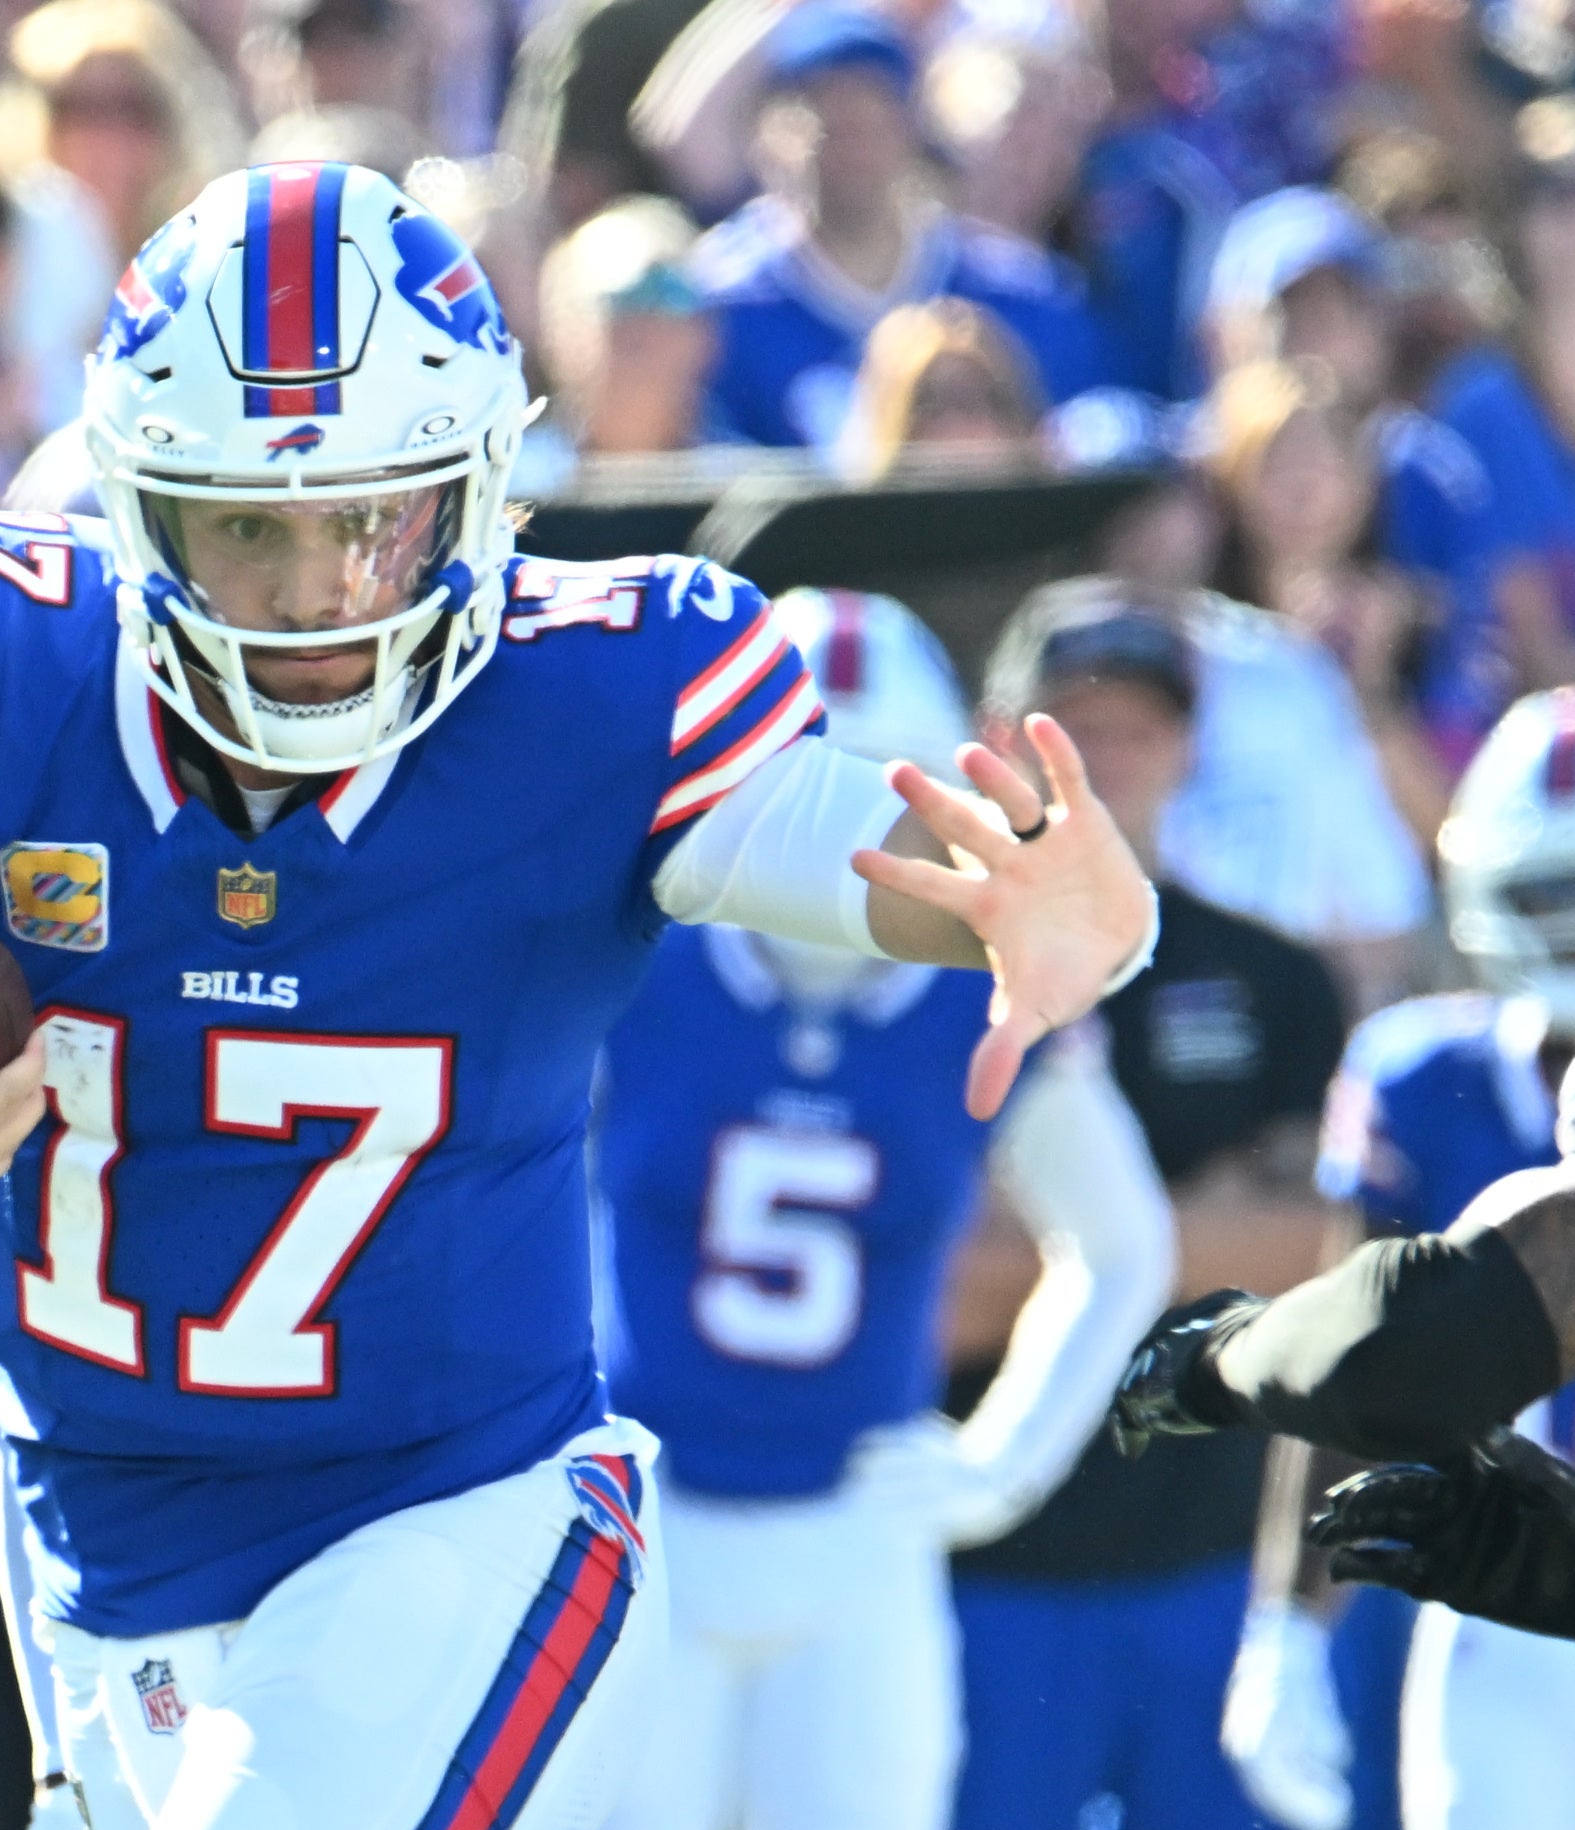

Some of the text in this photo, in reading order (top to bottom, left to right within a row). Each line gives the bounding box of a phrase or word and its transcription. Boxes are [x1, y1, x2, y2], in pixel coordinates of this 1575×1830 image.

[224, 892, 268, 919] NFL
[181, 971, 300, 1009] BILLS
[16, 1005, 458, 1399] 17
[691, 1119, 881, 1371] 5
